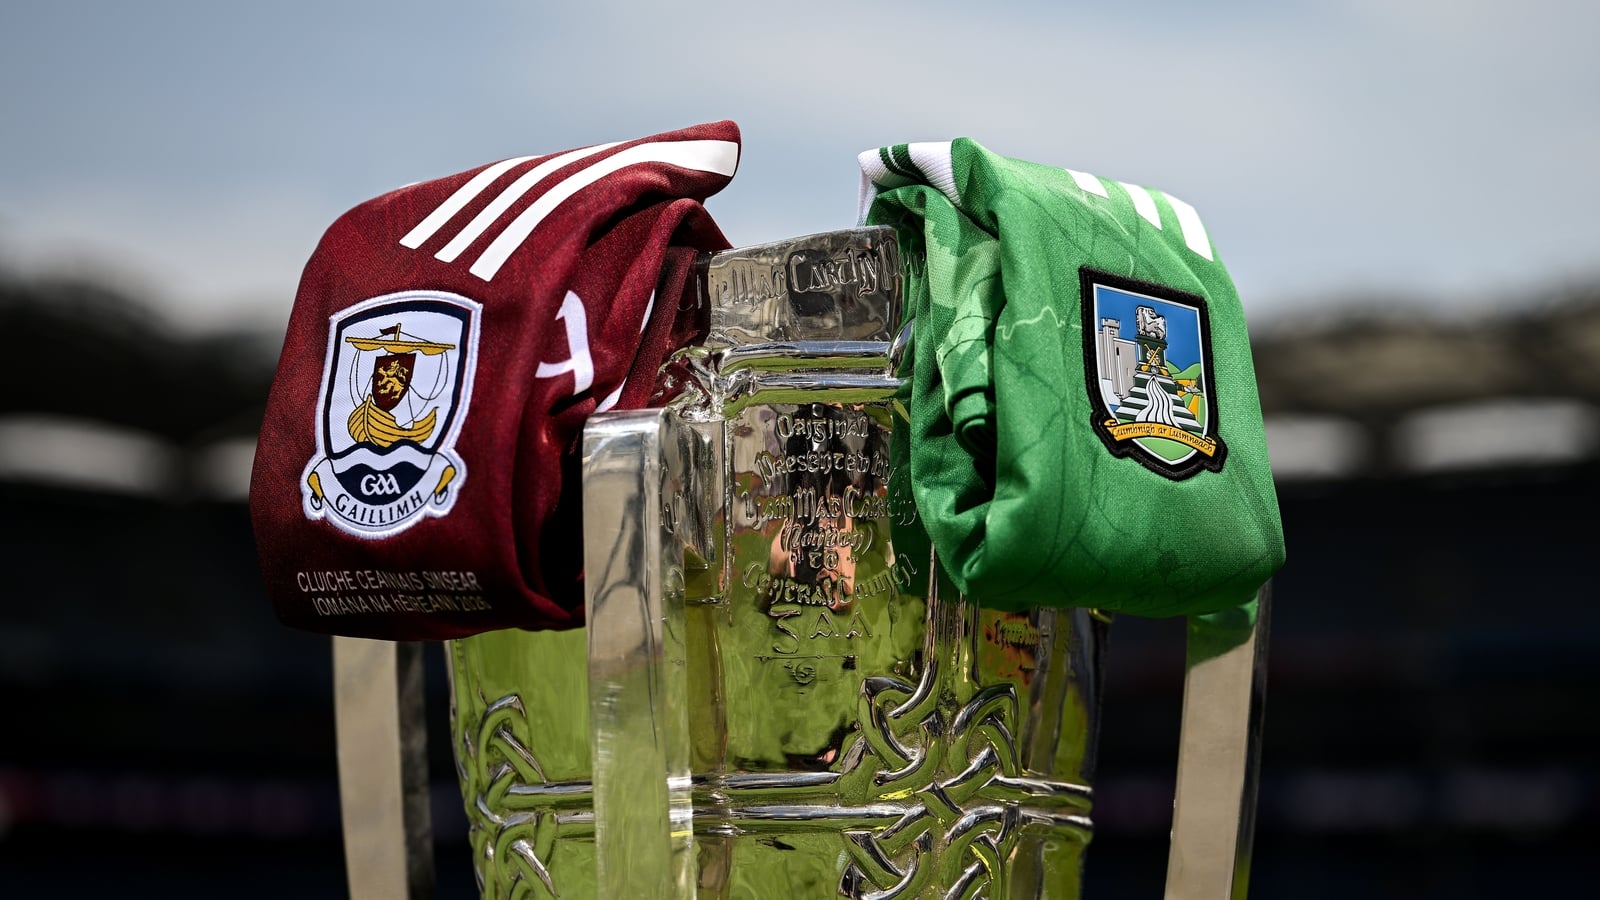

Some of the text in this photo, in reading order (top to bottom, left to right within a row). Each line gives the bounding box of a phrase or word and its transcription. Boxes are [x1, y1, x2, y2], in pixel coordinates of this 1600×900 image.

[360, 473, 401, 496] GAA
[335, 491, 424, 524] GAILLIMH
[297, 570, 357, 592] CLUICHE
[368, 594, 395, 613] NA
